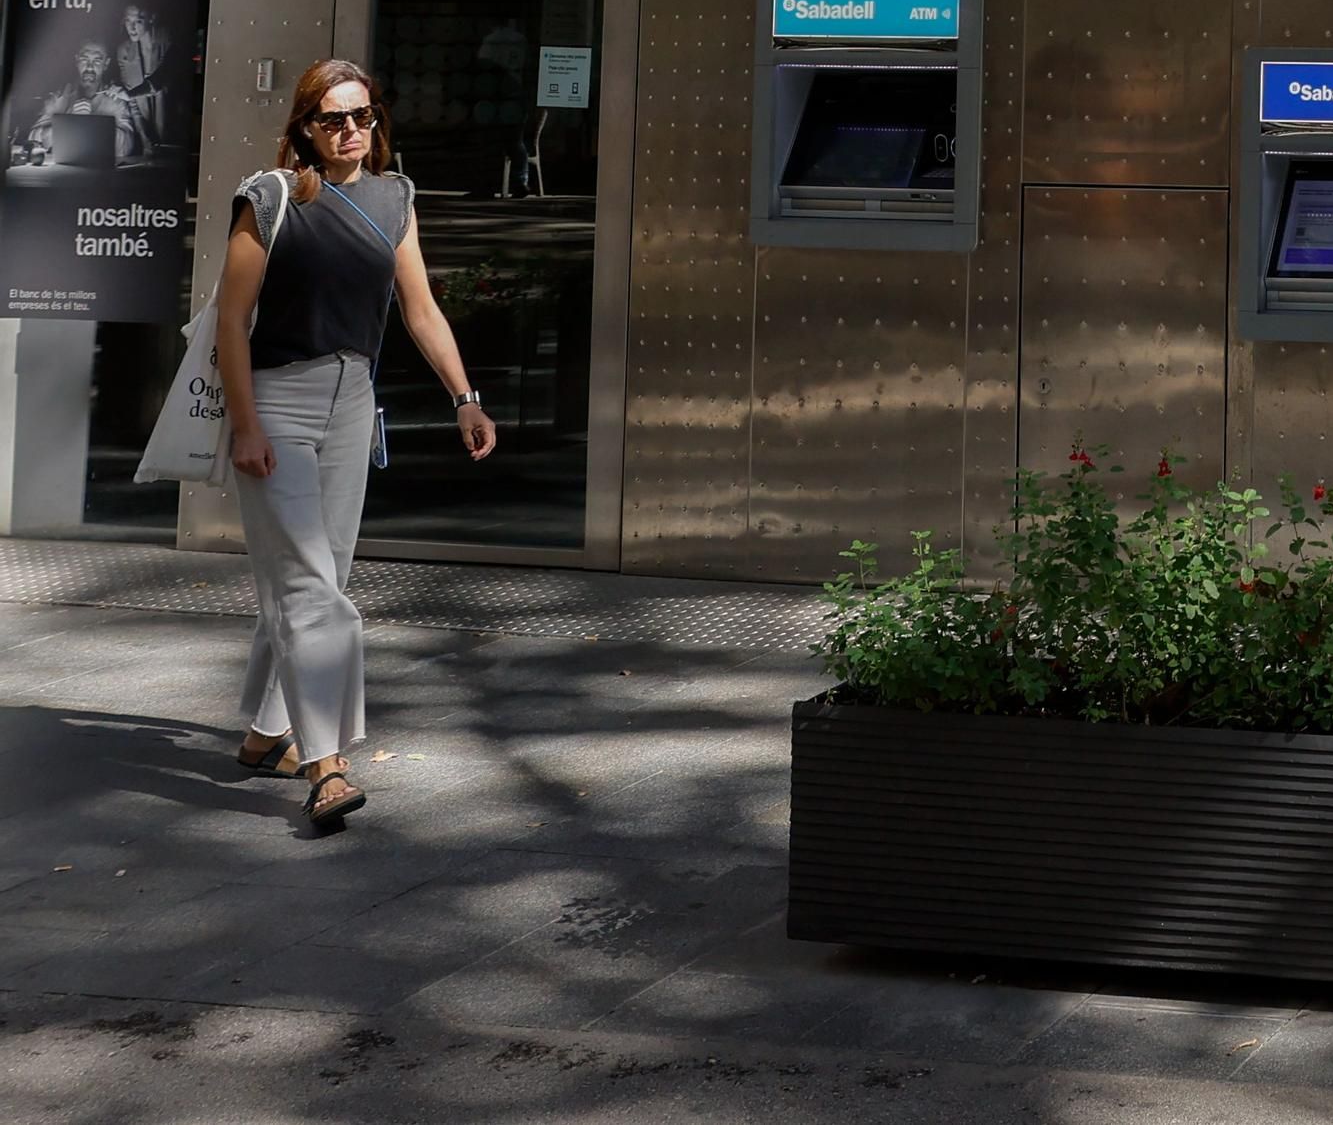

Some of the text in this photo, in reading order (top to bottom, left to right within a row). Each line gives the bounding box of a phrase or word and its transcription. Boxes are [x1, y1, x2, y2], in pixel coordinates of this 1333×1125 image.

[794, 0, 874, 18] Sabadell
[909, 7, 936, 19] ATM
[77, 202, 177, 227] nosaltres
[75, 231, 152, 256] també.
